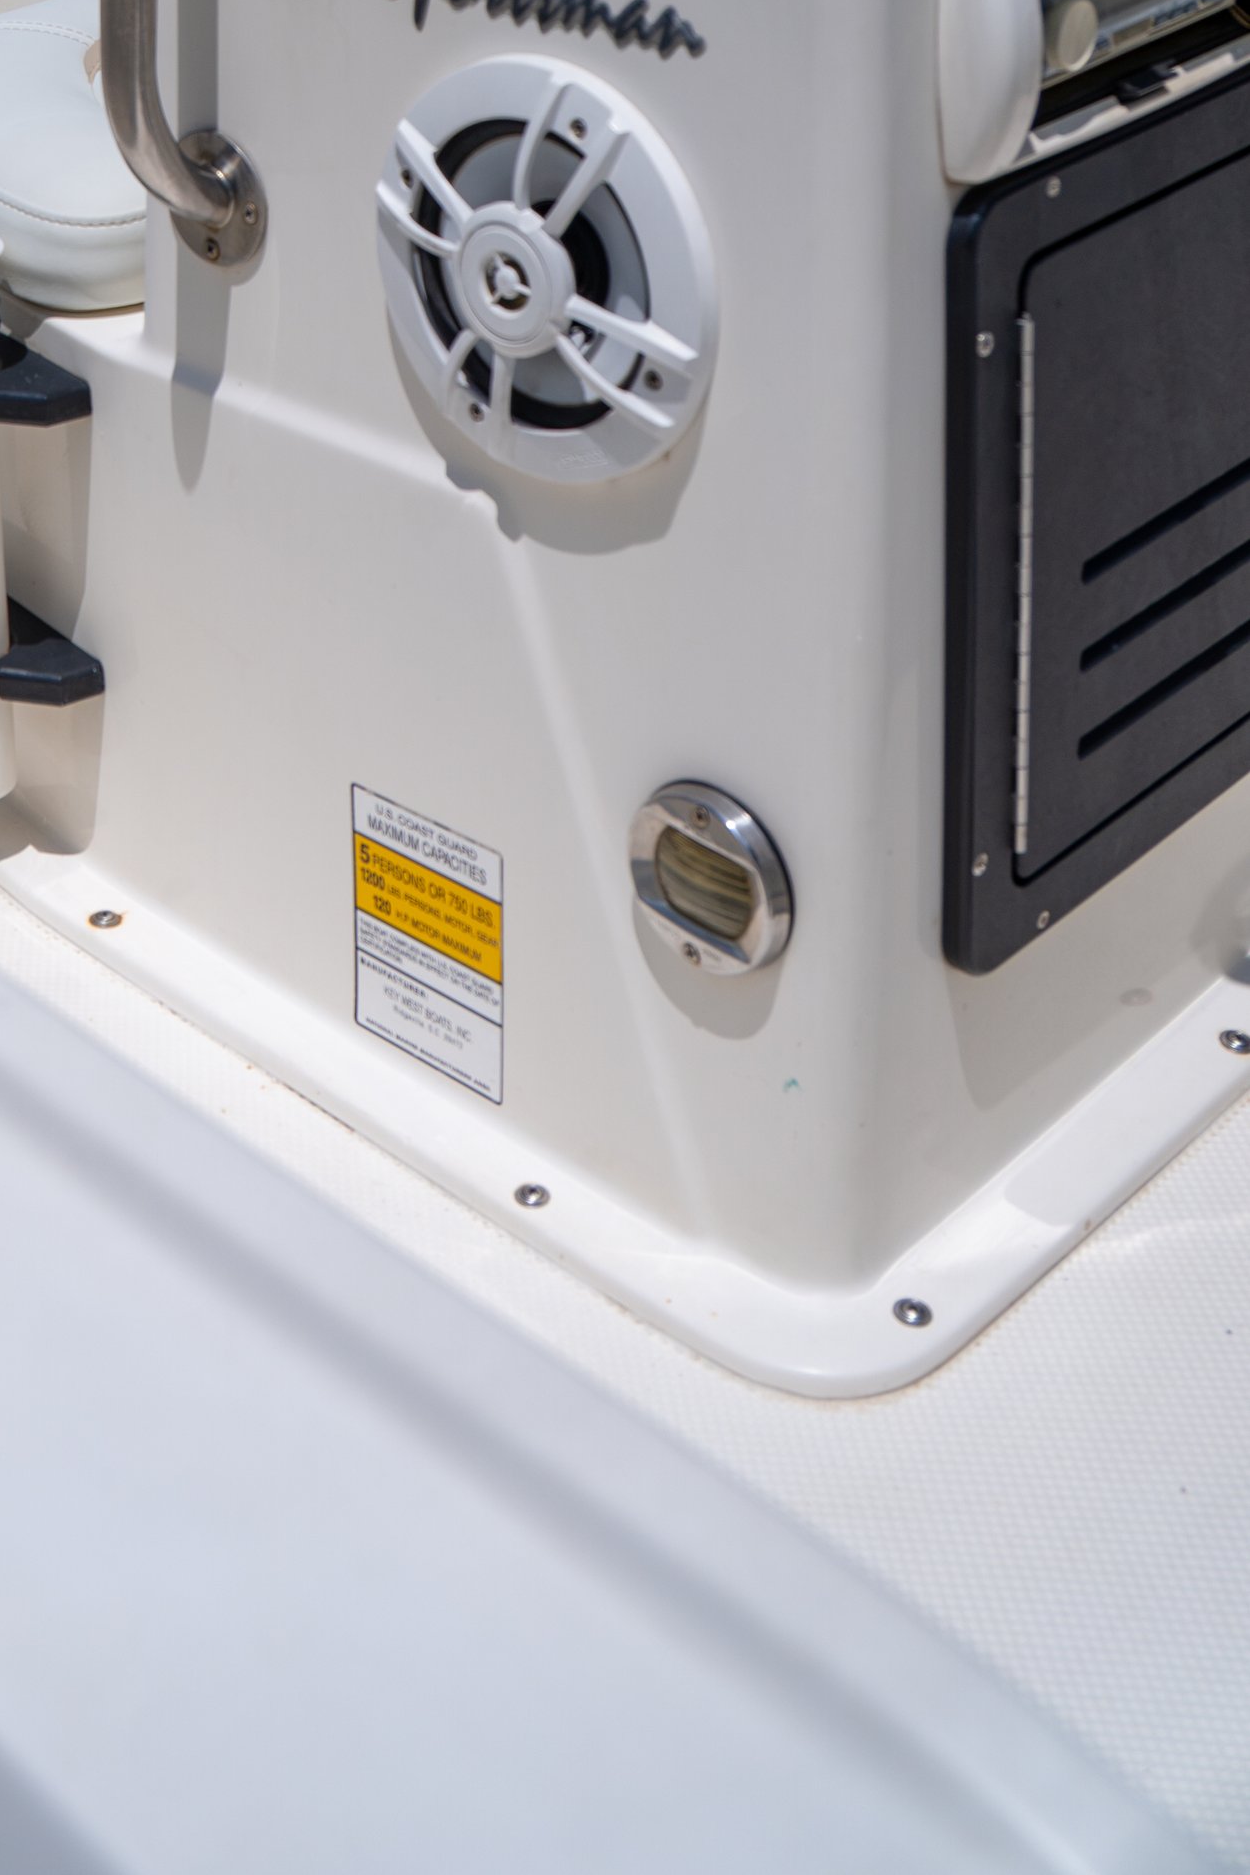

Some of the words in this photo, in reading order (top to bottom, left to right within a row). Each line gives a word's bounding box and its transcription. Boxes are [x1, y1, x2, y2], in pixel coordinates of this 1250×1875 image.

[368, 814, 420, 851] MAXIMUM
[422, 841, 487, 885] CAPACITIES
[398, 814, 434, 840] COAST
[438, 833, 478, 861] GUARD
[360, 843, 370, 863] 5
[373, 854, 425, 892] PERSONS
[429, 882, 446, 902] OR
[448, 892, 467, 914] 750
[360, 867, 385, 890] 1200
[373, 895, 391, 915] 120
[412, 919, 440, 940] MOTOR
[443, 934, 481, 962] MAXIMUM
